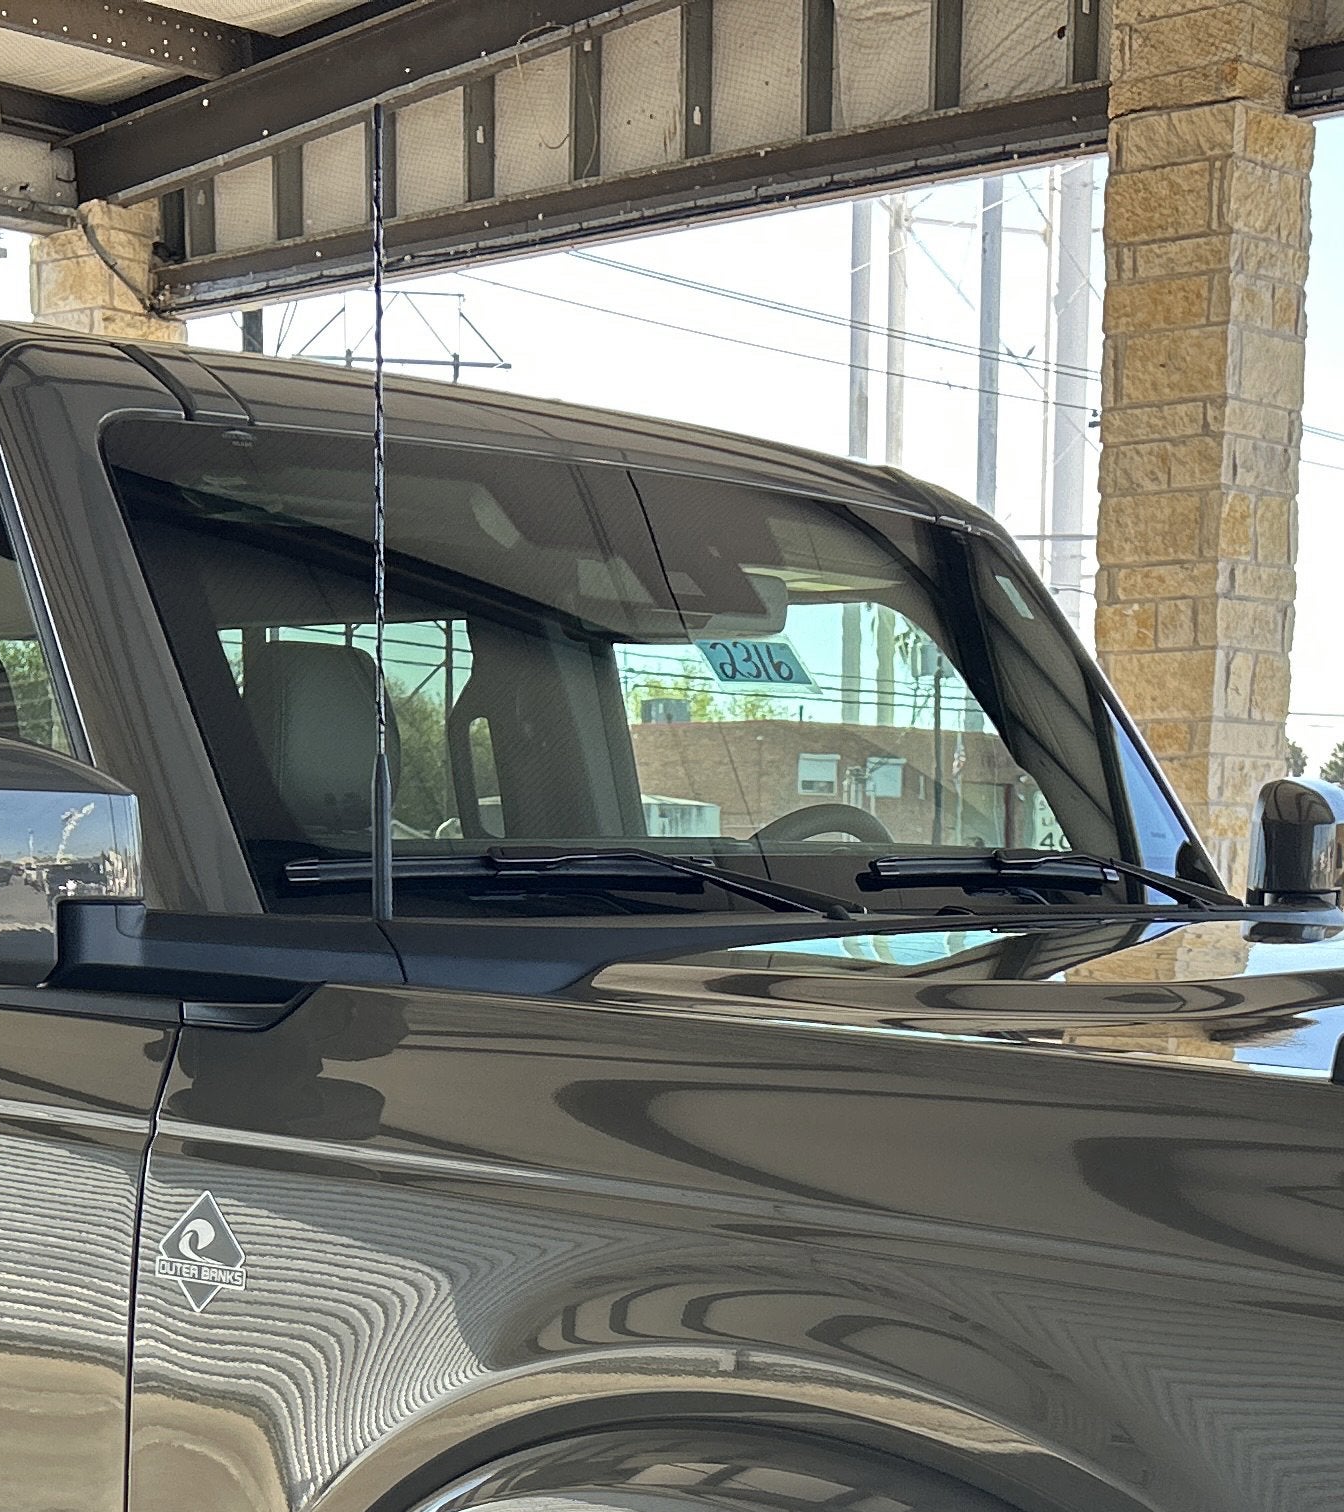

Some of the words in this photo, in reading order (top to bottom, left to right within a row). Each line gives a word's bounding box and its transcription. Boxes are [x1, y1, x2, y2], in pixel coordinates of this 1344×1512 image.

[710, 642, 793, 681] 2316
[159, 1260, 198, 1279] OUTER
[201, 1266, 242, 1286] BANKS
